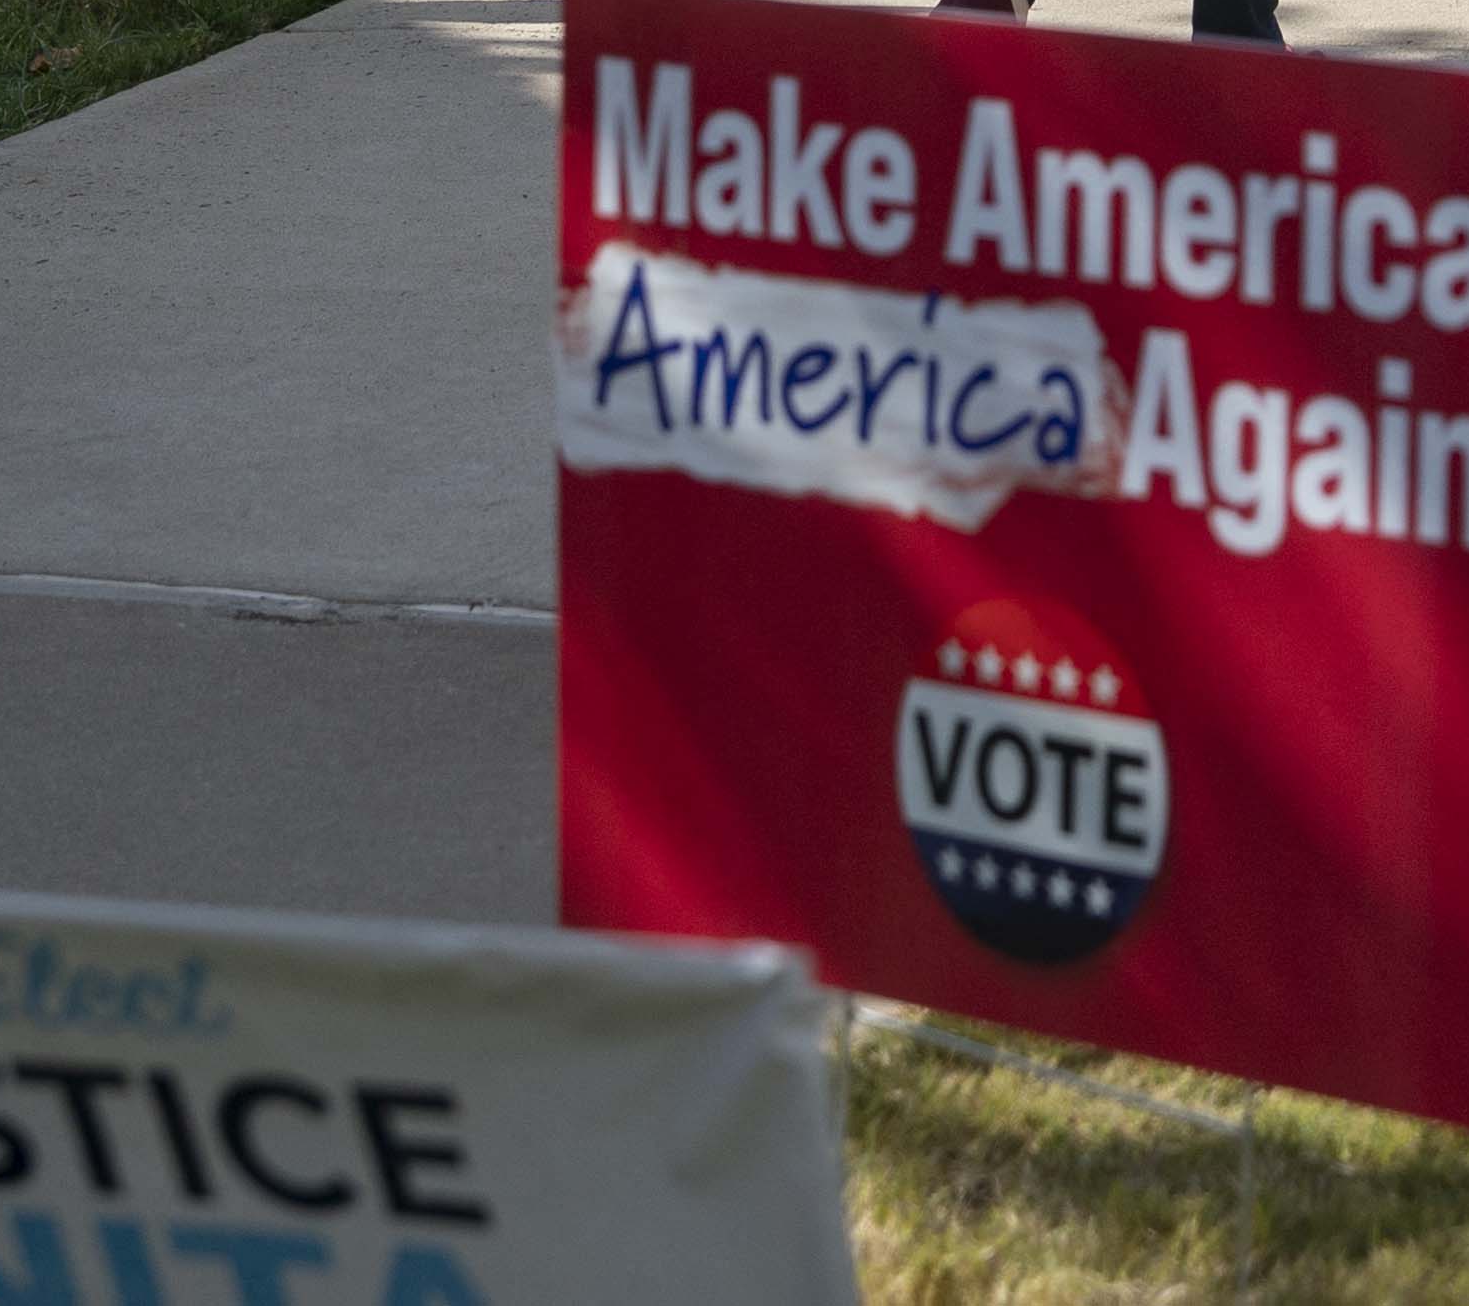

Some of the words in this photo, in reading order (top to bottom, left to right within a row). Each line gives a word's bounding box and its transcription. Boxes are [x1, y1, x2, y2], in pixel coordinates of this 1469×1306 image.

[593, 53, 919, 257] Make
[593, 258, 1085, 467] America
[914, 706, 1152, 853] VOTE
